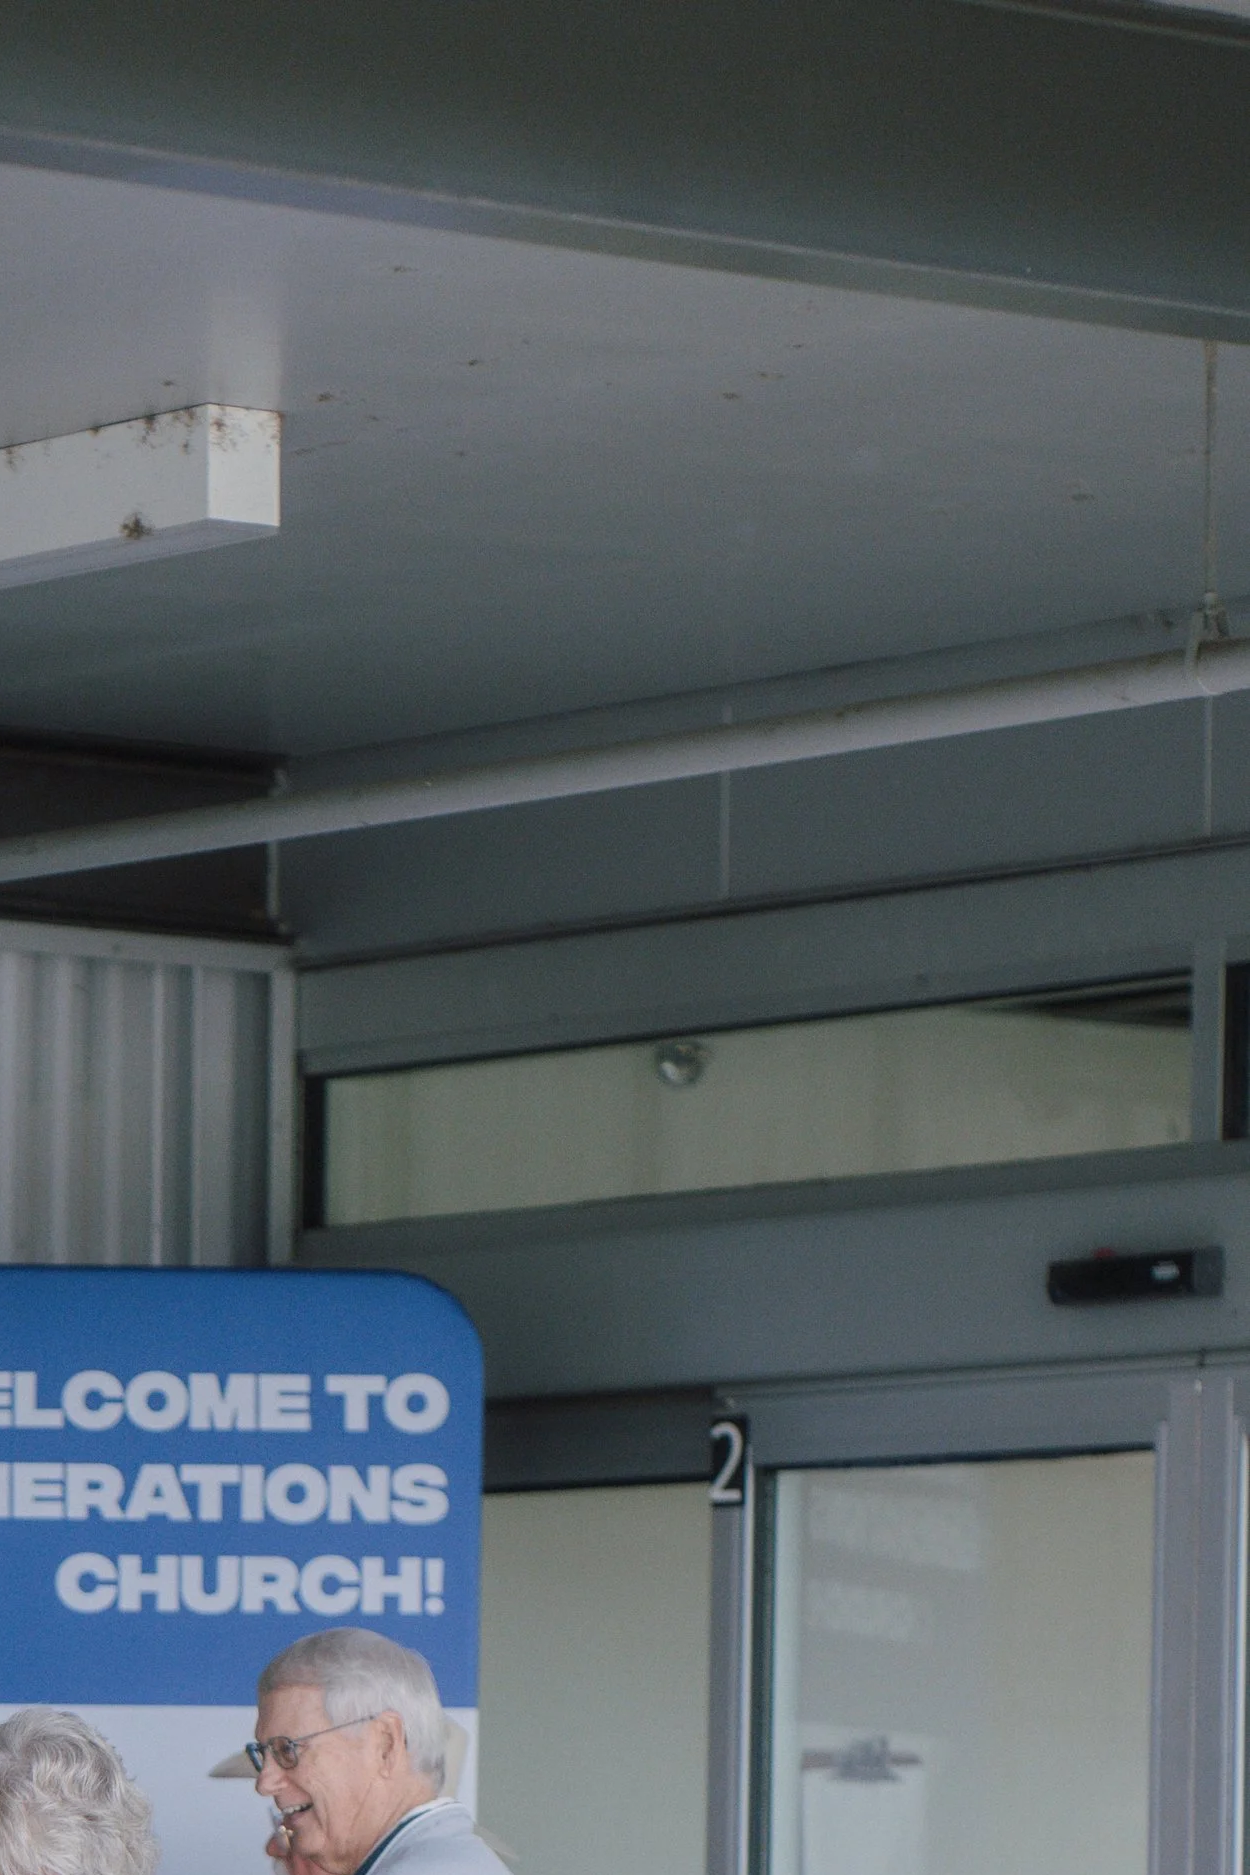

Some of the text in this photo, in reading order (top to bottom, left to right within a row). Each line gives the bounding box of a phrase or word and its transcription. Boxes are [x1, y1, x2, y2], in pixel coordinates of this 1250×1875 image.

[327, 1374, 449, 1433] TO
[710, 1421, 742, 1501] 2
[56, 1552, 445, 1615] CHURCH!
